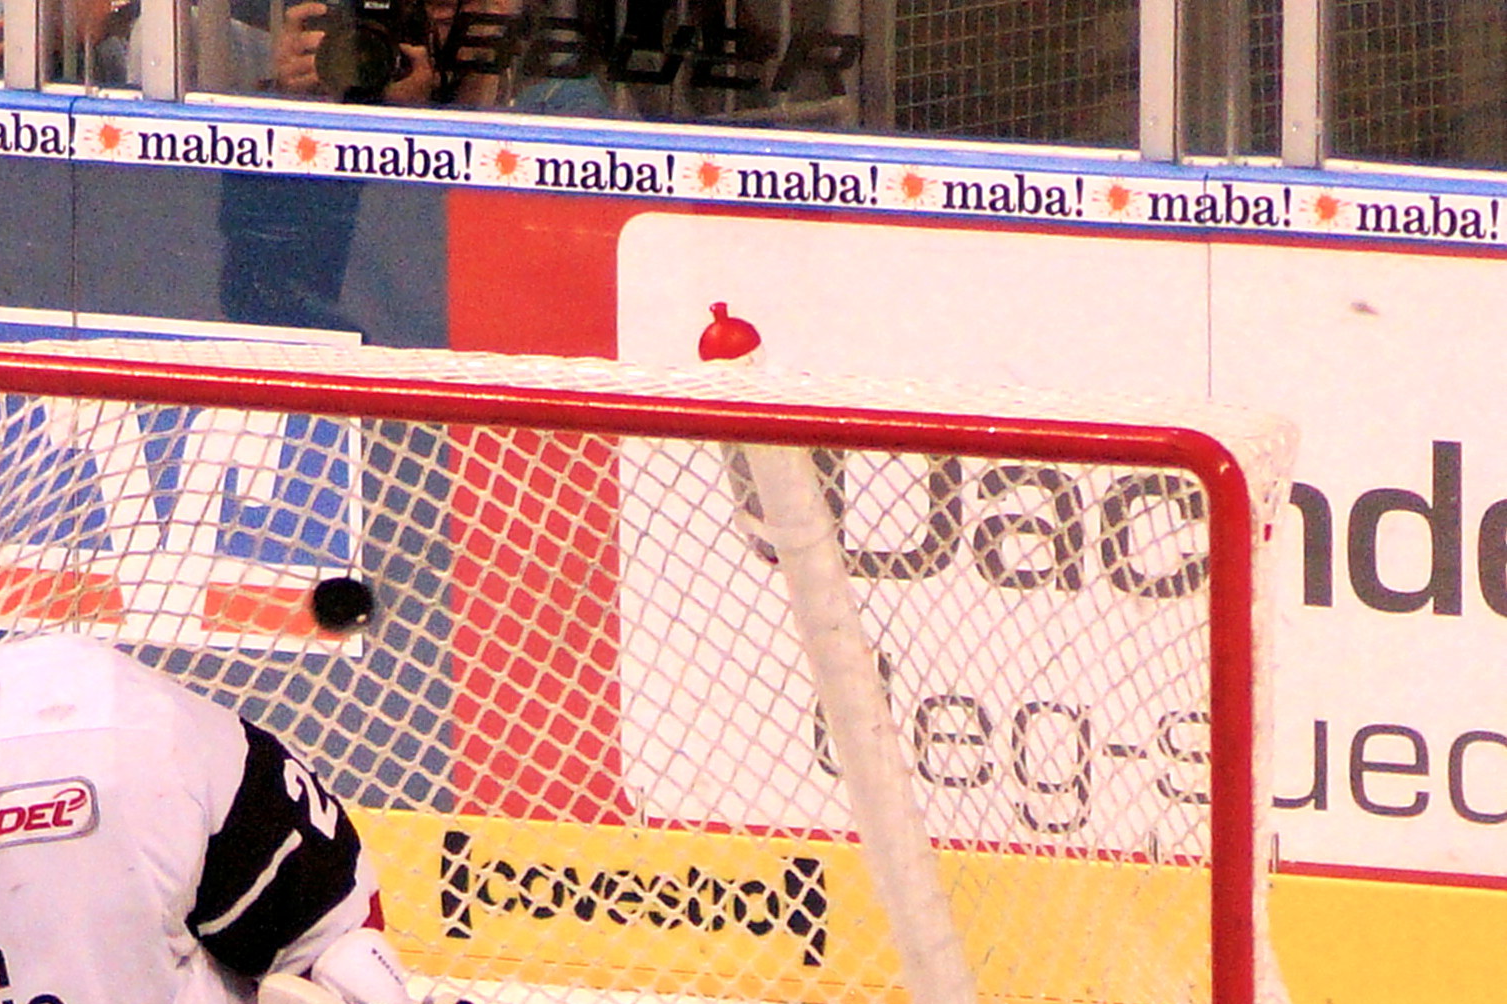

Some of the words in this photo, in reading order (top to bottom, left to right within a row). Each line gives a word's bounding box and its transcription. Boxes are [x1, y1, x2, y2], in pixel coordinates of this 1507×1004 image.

[138, 125, 275, 168] maba!
[335, 139, 472, 181] maba!
[535, 151, 676, 194] maba!
[737, 162, 879, 205] maba!
[943, 174, 1085, 218] maba!
[1148, 185, 1293, 229] maba!
[1357, 197, 1501, 241] maba!
